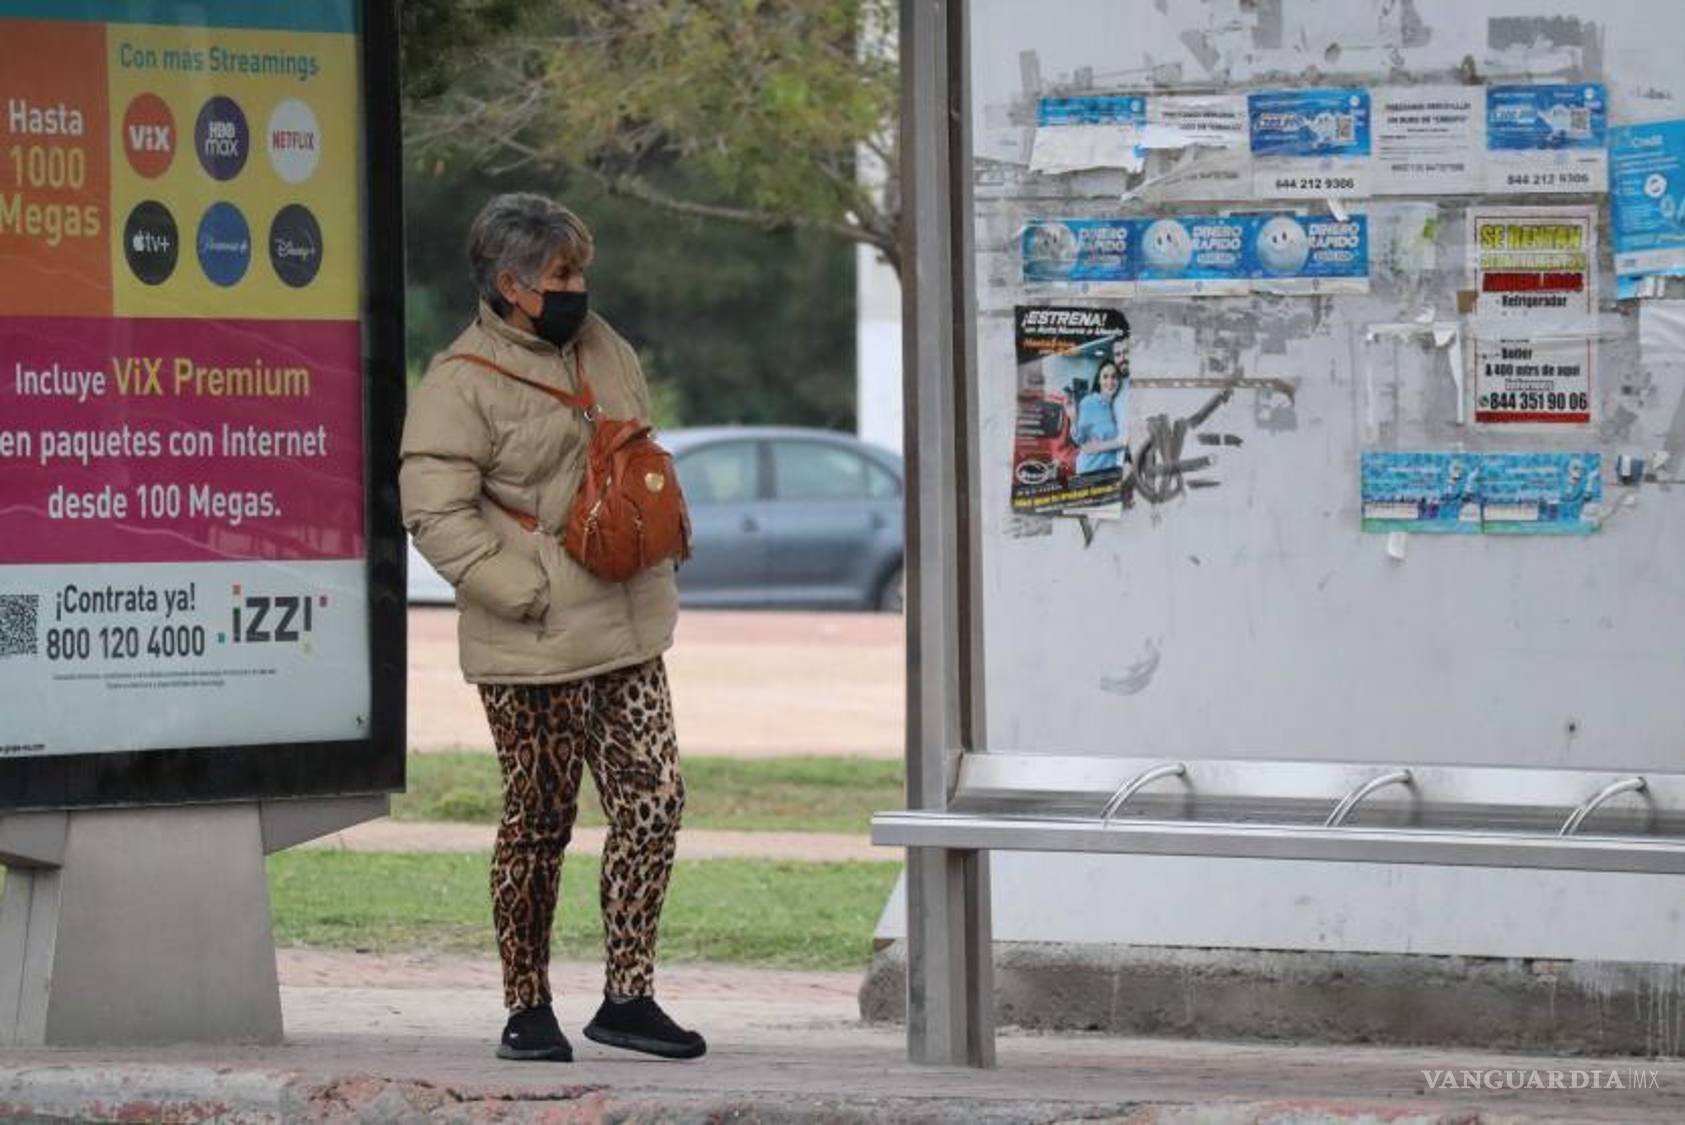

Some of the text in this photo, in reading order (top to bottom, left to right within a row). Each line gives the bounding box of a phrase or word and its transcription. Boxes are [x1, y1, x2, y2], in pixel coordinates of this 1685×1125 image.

[120, 43, 157, 68] Con
[209, 46, 320, 81] Streamings
[8, 98, 84, 135] Hasta
[209, 121, 236, 139] HBO
[205, 139, 239, 157] max
[272, 130, 316, 151] NETFLIX
[9, 145, 85, 189] 1000
[1300, 178, 1322, 189] 212
[0, 192, 101, 248] Megas
[1020, 310, 1108, 328] ¡ESTRENA!
[1502, 295, 1567, 308] Refrigerador
[15, 356, 311, 404] Incluye ViX Premium
[1542, 363, 1555, 376] de
[1490, 392, 1587, 410] 844 351 90 06
[0, 423, 328, 466] en paquetes con Internet
[48, 484, 282, 526] desde 100 Megas.
[55, 582, 197, 622] ¡Contrata ya!
[46, 625, 206, 660] 800 120 4000
